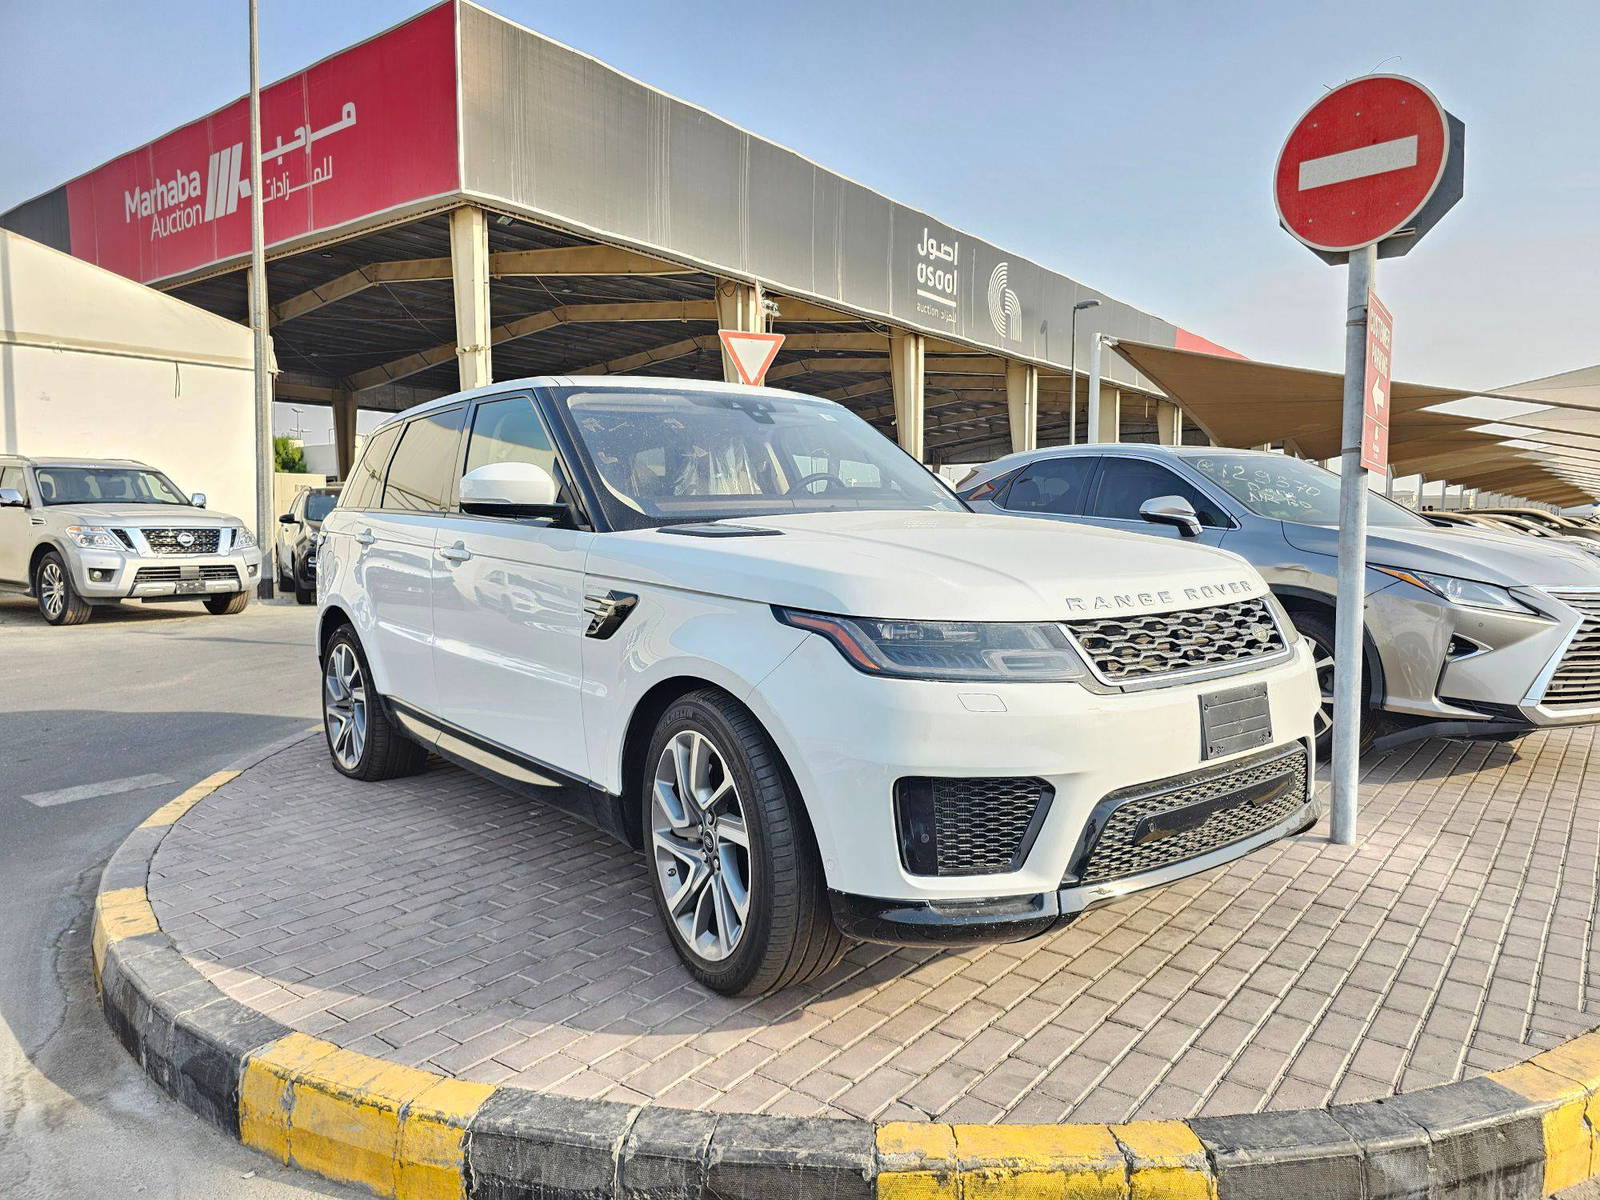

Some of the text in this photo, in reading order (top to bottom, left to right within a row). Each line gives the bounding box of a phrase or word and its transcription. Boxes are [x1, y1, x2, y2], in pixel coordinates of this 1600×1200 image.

[124, 168, 202, 224] Marhaba
[150, 203, 203, 242] Auction
[916, 302, 939, 318] auction
[1065, 580, 1253, 613] RANGE ROVER
